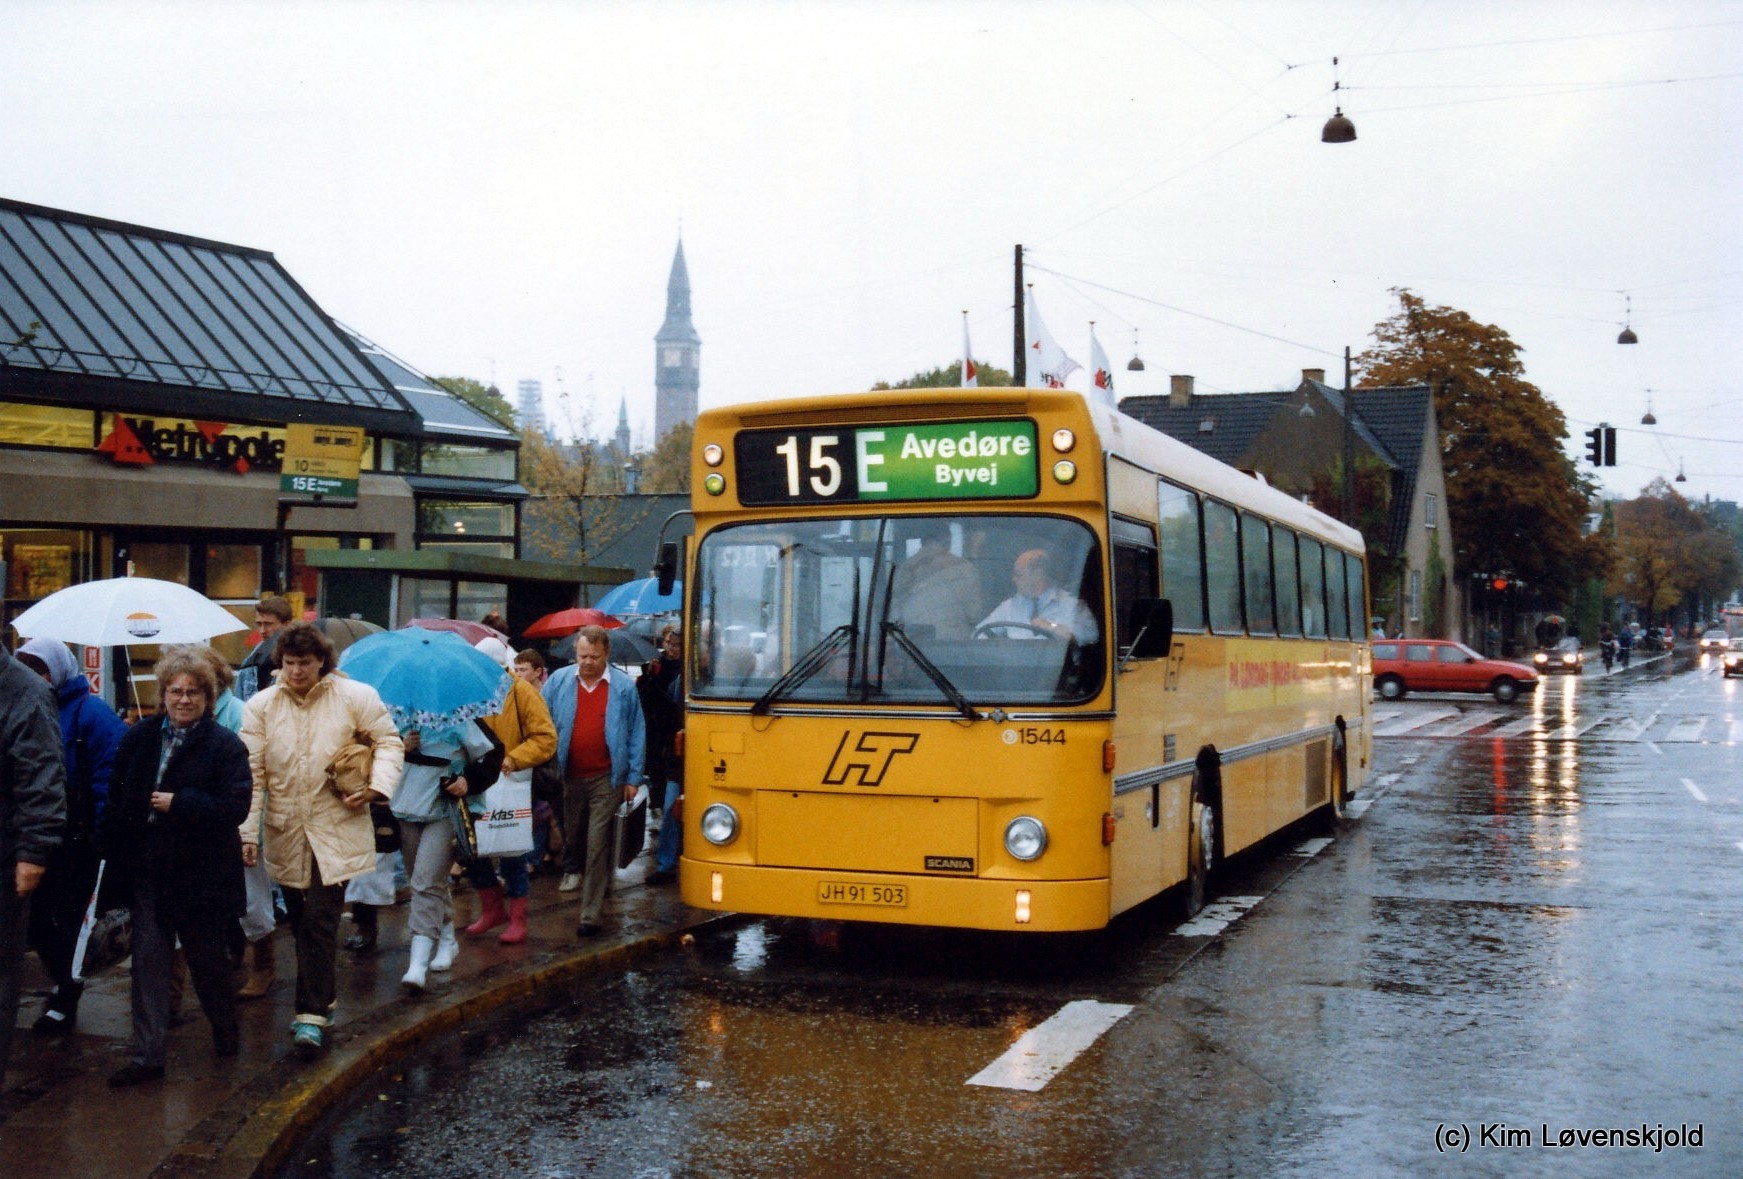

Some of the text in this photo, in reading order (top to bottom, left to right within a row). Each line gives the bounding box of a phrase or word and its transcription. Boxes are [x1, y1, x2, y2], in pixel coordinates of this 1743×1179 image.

[900, 430, 1031, 459] Avedøre
[935, 463, 998, 487] Byvej
[1018, 727, 1067, 746] 1544
[821, 729, 921, 787] HT
[926, 858, 972, 871] SCANIA
[821, 886, 904, 903] JH 91 503
